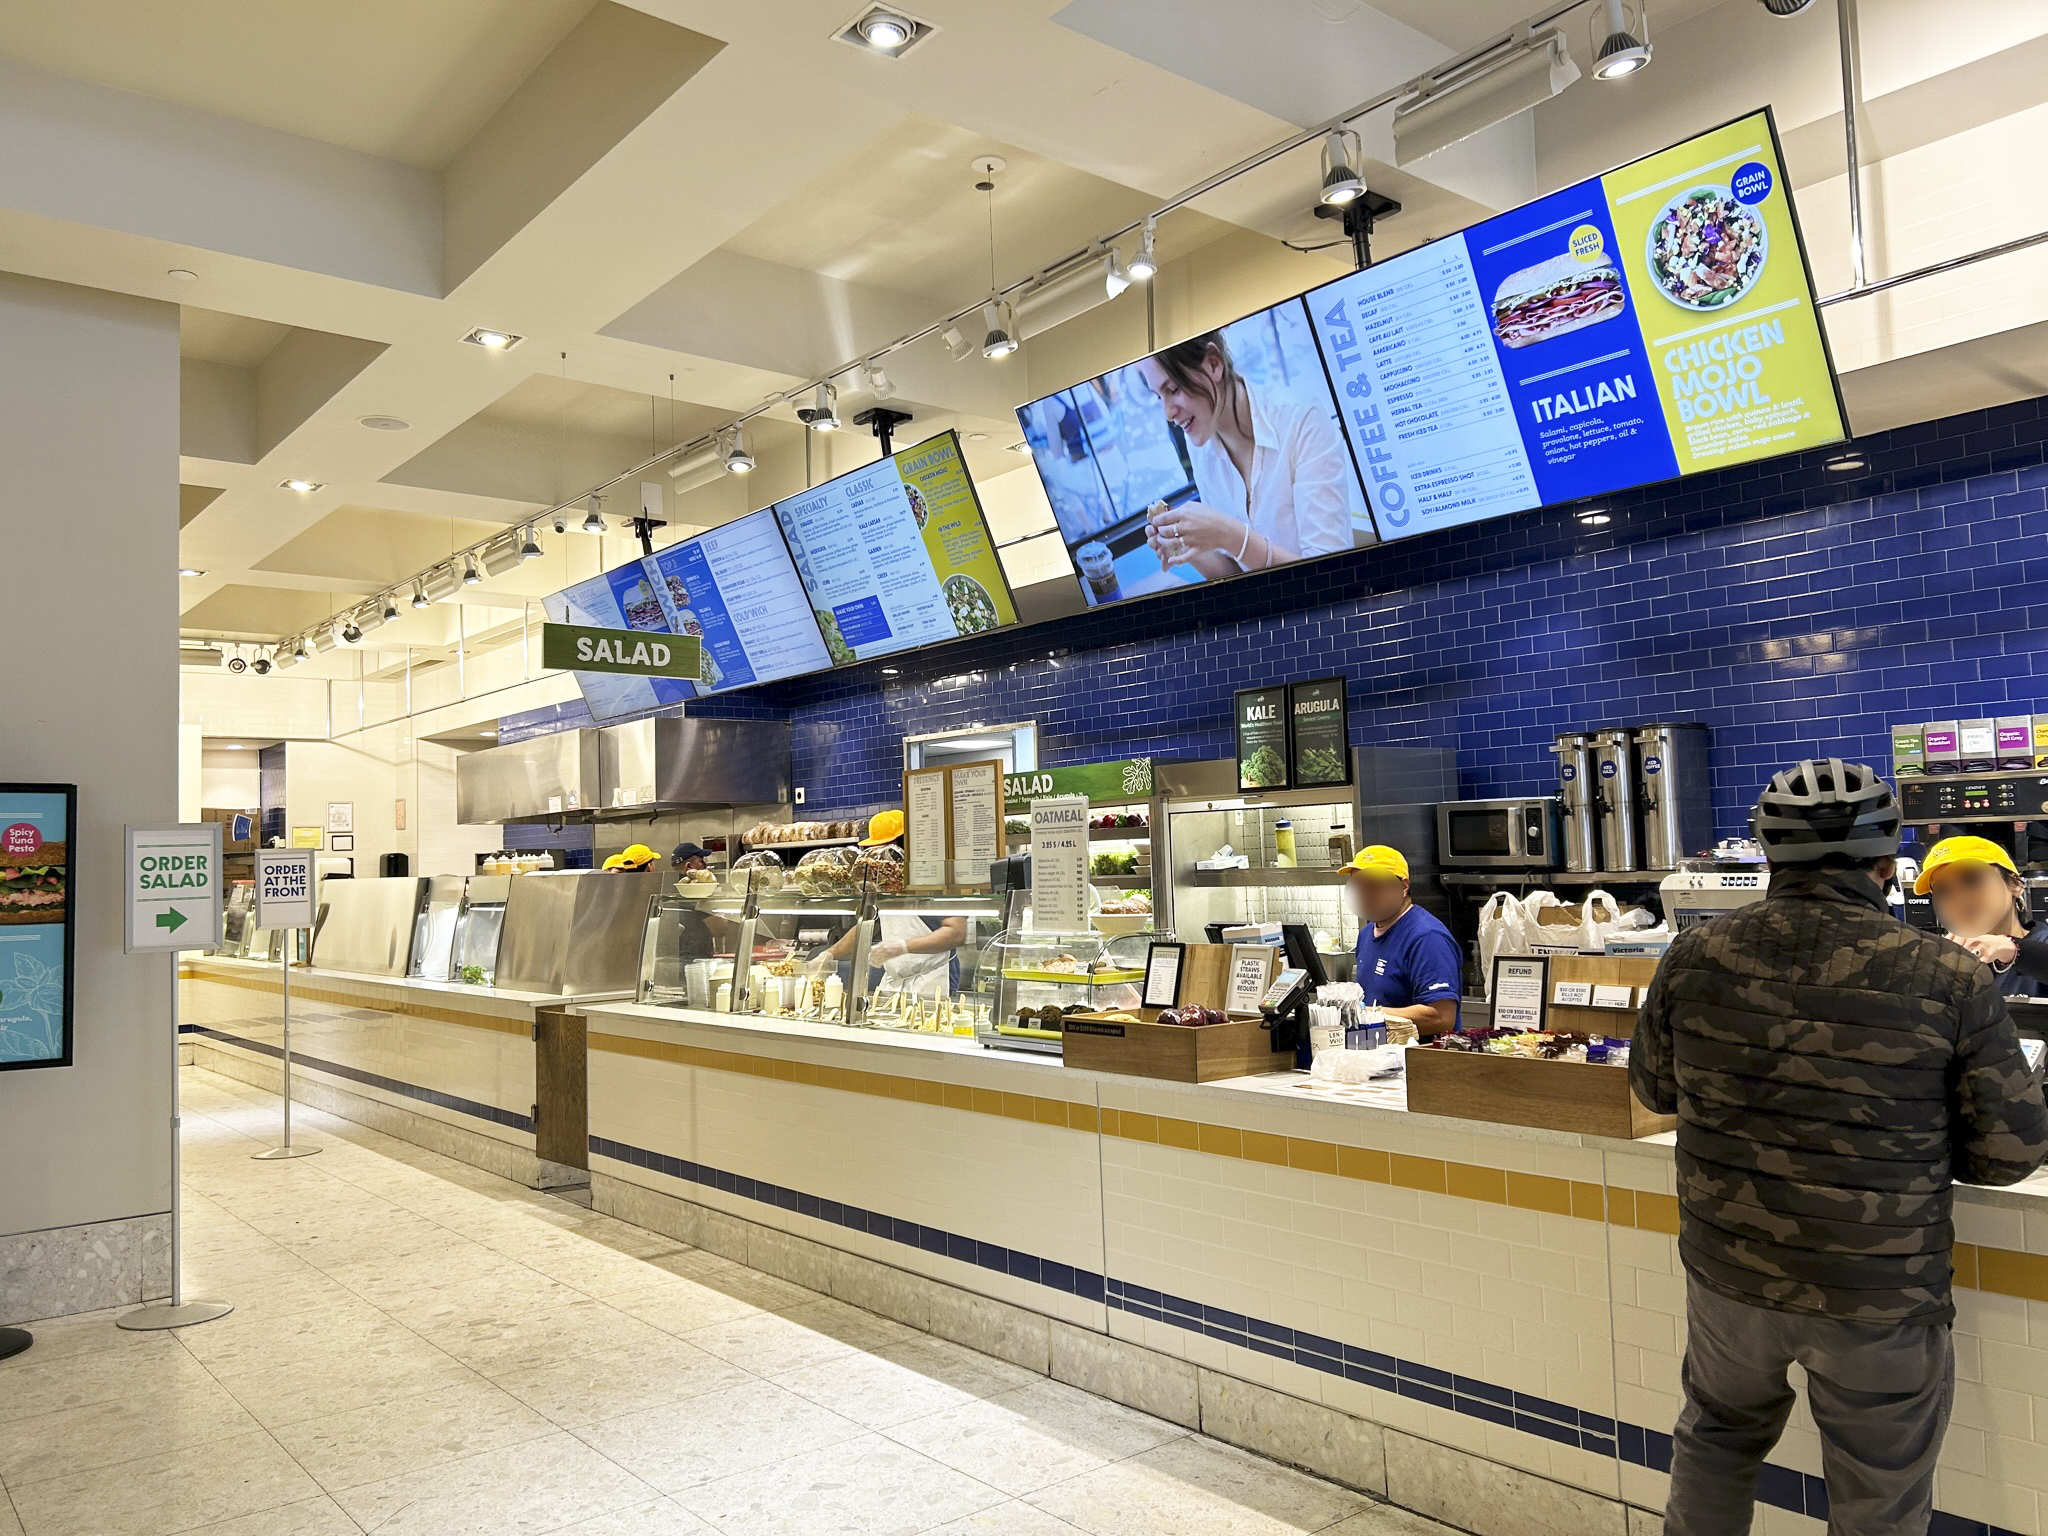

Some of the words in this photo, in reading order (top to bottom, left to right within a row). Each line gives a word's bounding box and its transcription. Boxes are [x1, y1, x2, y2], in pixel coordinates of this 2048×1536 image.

[1736, 170, 1765, 188] GRAIN
[1738, 181, 1768, 198] BOWL
[1572, 233, 1598, 248] SLICED
[1575, 242, 1600, 257] FRESH
[1357, 295, 1376, 307] HOUSE
[1377, 288, 1394, 300] BLEND
[1361, 308, 1378, 319] DECAF
[1365, 316, 1394, 331] HAZELNUT
[1324, 298, 1362, 372] TEA
[1369, 332, 1382, 344] CAFE
[1383, 331, 1391, 339] AU
[1391, 327, 1404, 337] LAIT
[1373, 340, 1406, 356] AMERICANO
[1664, 319, 1785, 372] CHICKEN
[1376, 358, 1392, 368] LATTE
[1380, 365, 1413, 380] CAPPUCCINO
[1672, 356, 1762, 399] MOJO
[1346, 372, 1372, 398] &
[1384, 376, 1420, 393] MOCHACCINO
[1387, 392, 1414, 404] ESPRESSO
[1532, 374, 1637, 423] ITALIAN
[1677, 382, 1770, 422] BOWL
[1390, 406, 1412, 417] HERBAL
[1412, 403, 1423, 411] TEA
[1686, 421, 1709, 432] Brown
[1710, 418, 1724, 426] rice
[1726, 413, 1743, 423] with
[1744, 407, 1771, 419] quinoa
[1781, 398, 1804, 409] lentil,
[1394, 420, 1406, 429] HOT
[1407, 411, 1439, 426] CHOCOLATE
[1540, 426, 1568, 439] Salami,
[1569, 418, 1604, 431] capicola,
[1688, 429, 1711, 440] grilled
[1712, 422, 1743, 433] chicken,
[1744, 416, 1764, 426] baby
[1765, 409, 1798, 421] spinach,
[1398, 430, 1415, 441] FRESH
[1416, 427, 1427, 436] ICED
[1542, 433, 1582, 449] provolone,
[1582, 424, 1612, 438] lettuce,
[1613, 417, 1644, 430] tomato,
[1688, 436, 1708, 446] black
[1710, 432, 1730, 441] bean,
[1732, 427, 1752, 435] corn,
[1753, 422, 1766, 431] red
[1768, 414, 1802, 427] cabbage
[1545, 444, 1569, 456] onion,
[1569, 442, 1582, 450] hot
[1583, 433, 1618, 448] peppers,
[1618, 429, 1629, 438] oil
[1691, 441, 1726, 452] cucumber
[1728, 435, 1748, 444] salsa
[1693, 447, 1726, 459] Dressing:
[1728, 440, 1751, 450] cuban
[1752, 436, 1771, 445] mojo
[1772, 431, 1795, 441] sauce
[902, 456, 928, 475] GRAIN
[928, 446, 955, 464] BOWL
[1353, 404, 1410, 528] COFFEE
[1547, 452, 1576, 465] vinegar
[1410, 471, 1422, 480] ICED
[1423, 467, 1442, 477] DRINKS
[1414, 482, 1431, 492] EXTRA
[1432, 476, 1459, 488] ESPRESSO
[1460, 472, 1475, 481] SHOT
[845, 478, 874, 498] CLASSIC
[1418, 494, 1432, 503] HALF
[1438, 491, 1452, 499] HALF
[795, 496, 828, 517] SPECIALTY
[1422, 502, 1460, 516] SOY/ALMOND
[1461, 498, 1476, 507] MILK
[704, 539, 718, 553] BEEF
[781, 511, 818, 593] SALAD
[660, 561, 672, 572] TOP
[576, 637, 671, 666] SALAD
[1247, 704, 1276, 721] KALE
[1295, 698, 1339, 715] ARUGULA
[914, 774, 939, 785] DRESSINGS
[954, 771, 970, 779] MAKE
[971, 769, 986, 778] YOUR
[1003, 774, 1053, 797] SALAD
[1034, 810, 1083, 824] OATMEAL
[9, 828, 35, 837] Spicy
[140, 855, 208, 872] ORDER
[264, 865, 306, 875] ORDER
[140, 873, 208, 890] SALAD
[264, 877, 278, 887] AT
[283, 876, 306, 886] THE
[265, 887, 306, 897] FRONT
